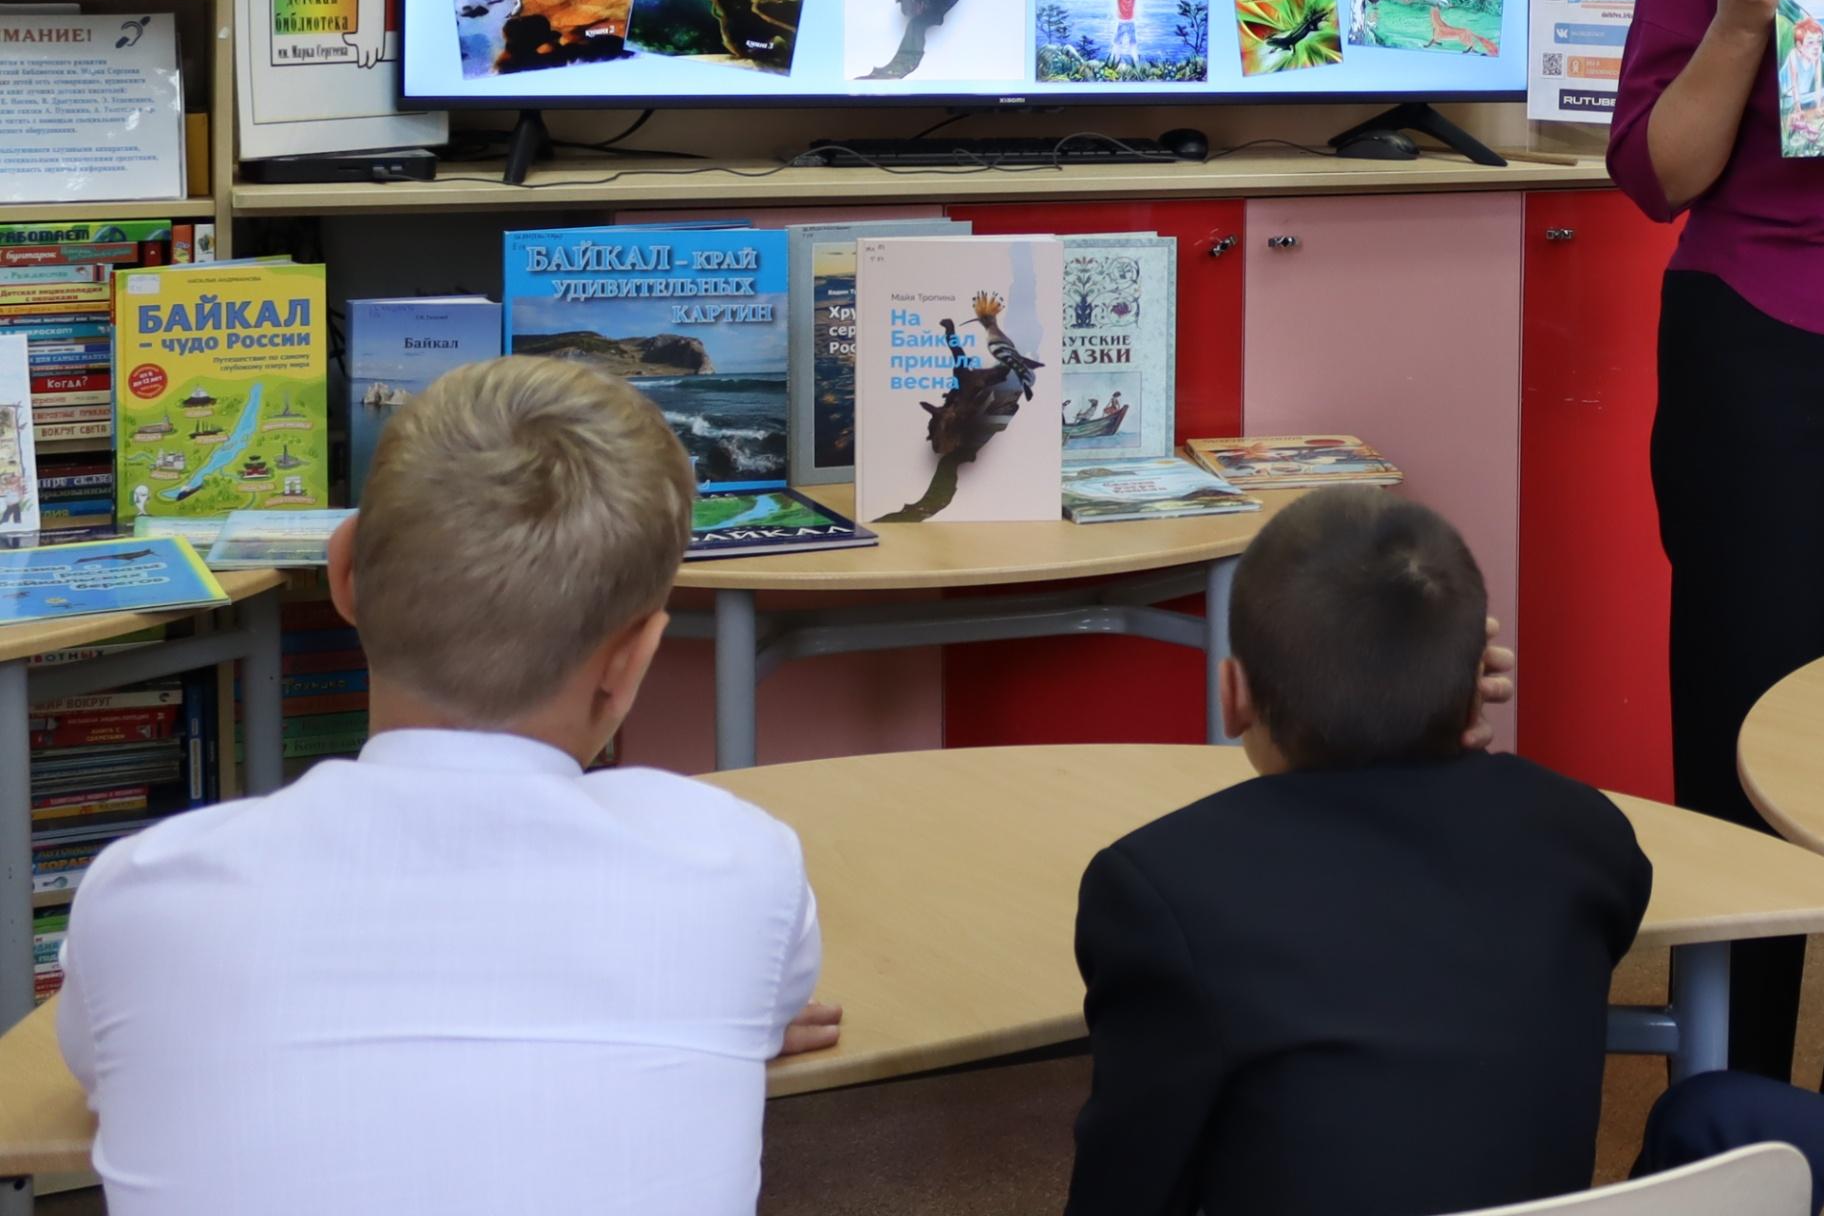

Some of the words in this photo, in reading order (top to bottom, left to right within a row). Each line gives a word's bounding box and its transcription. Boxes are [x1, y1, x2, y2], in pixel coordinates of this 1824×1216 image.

[275, 12, 349, 34] библиотека
[527, 241, 671, 272] БАЙКАЛ
[692, 247, 758, 270] КРАЙ
[551, 277, 755, 302] УДИВИТЕЛЬНЫХ
[891, 292, 915, 303] Майя
[917, 293, 956, 304] Тропина
[137, 294, 311, 334] БАЙКАЛ
[671, 304, 773, 325] КАРТИН
[890, 309, 921, 327] На
[161, 335, 219, 356] чудо
[226, 332, 311, 350] России
[404, 334, 459, 349] Байкал
[890, 330, 975, 349] Байкал
[890, 352, 982, 372] пришла
[890, 374, 960, 391] весна
